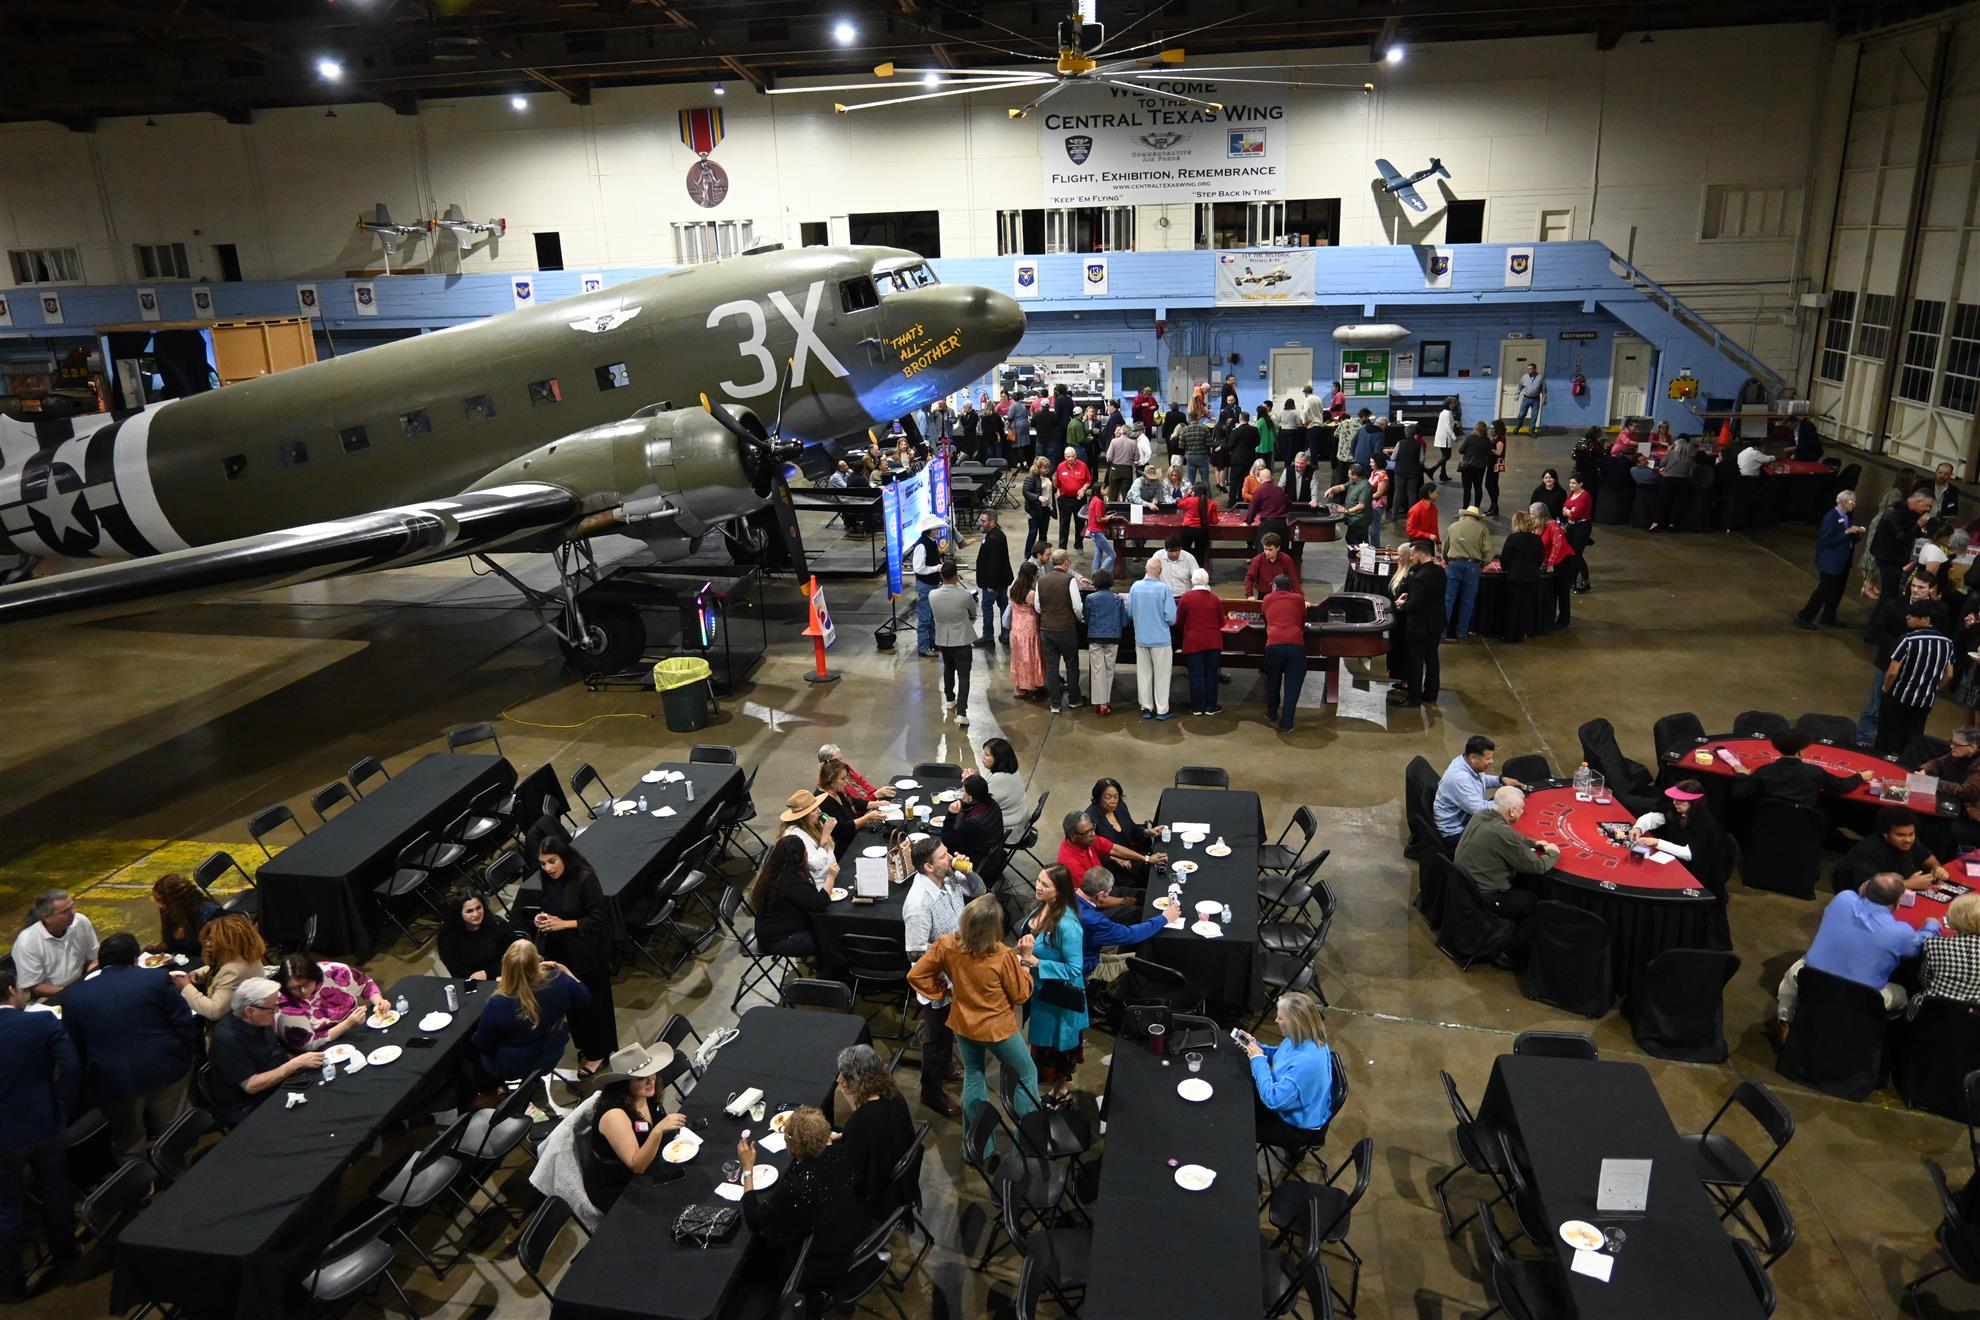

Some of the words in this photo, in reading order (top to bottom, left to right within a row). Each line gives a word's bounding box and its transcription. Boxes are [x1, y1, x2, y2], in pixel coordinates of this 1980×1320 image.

[1138, 99, 1156, 108] TO
[1045, 114, 1143, 130] CENTRAL
[1147, 109, 1217, 125] TEXAS
[1222, 105, 1283, 121] WING
[1052, 174, 1098, 183] FLIGHT,
[1102, 171, 1174, 182] EXHIBITION,
[1178, 166, 1276, 178] REMEMBRANCE
[1253, 188, 1276, 196] TIME"
[706, 281, 850, 398] 3X
[883, 323, 924, 350] "THAT'S
[902, 328, 962, 378] BROTHER"
